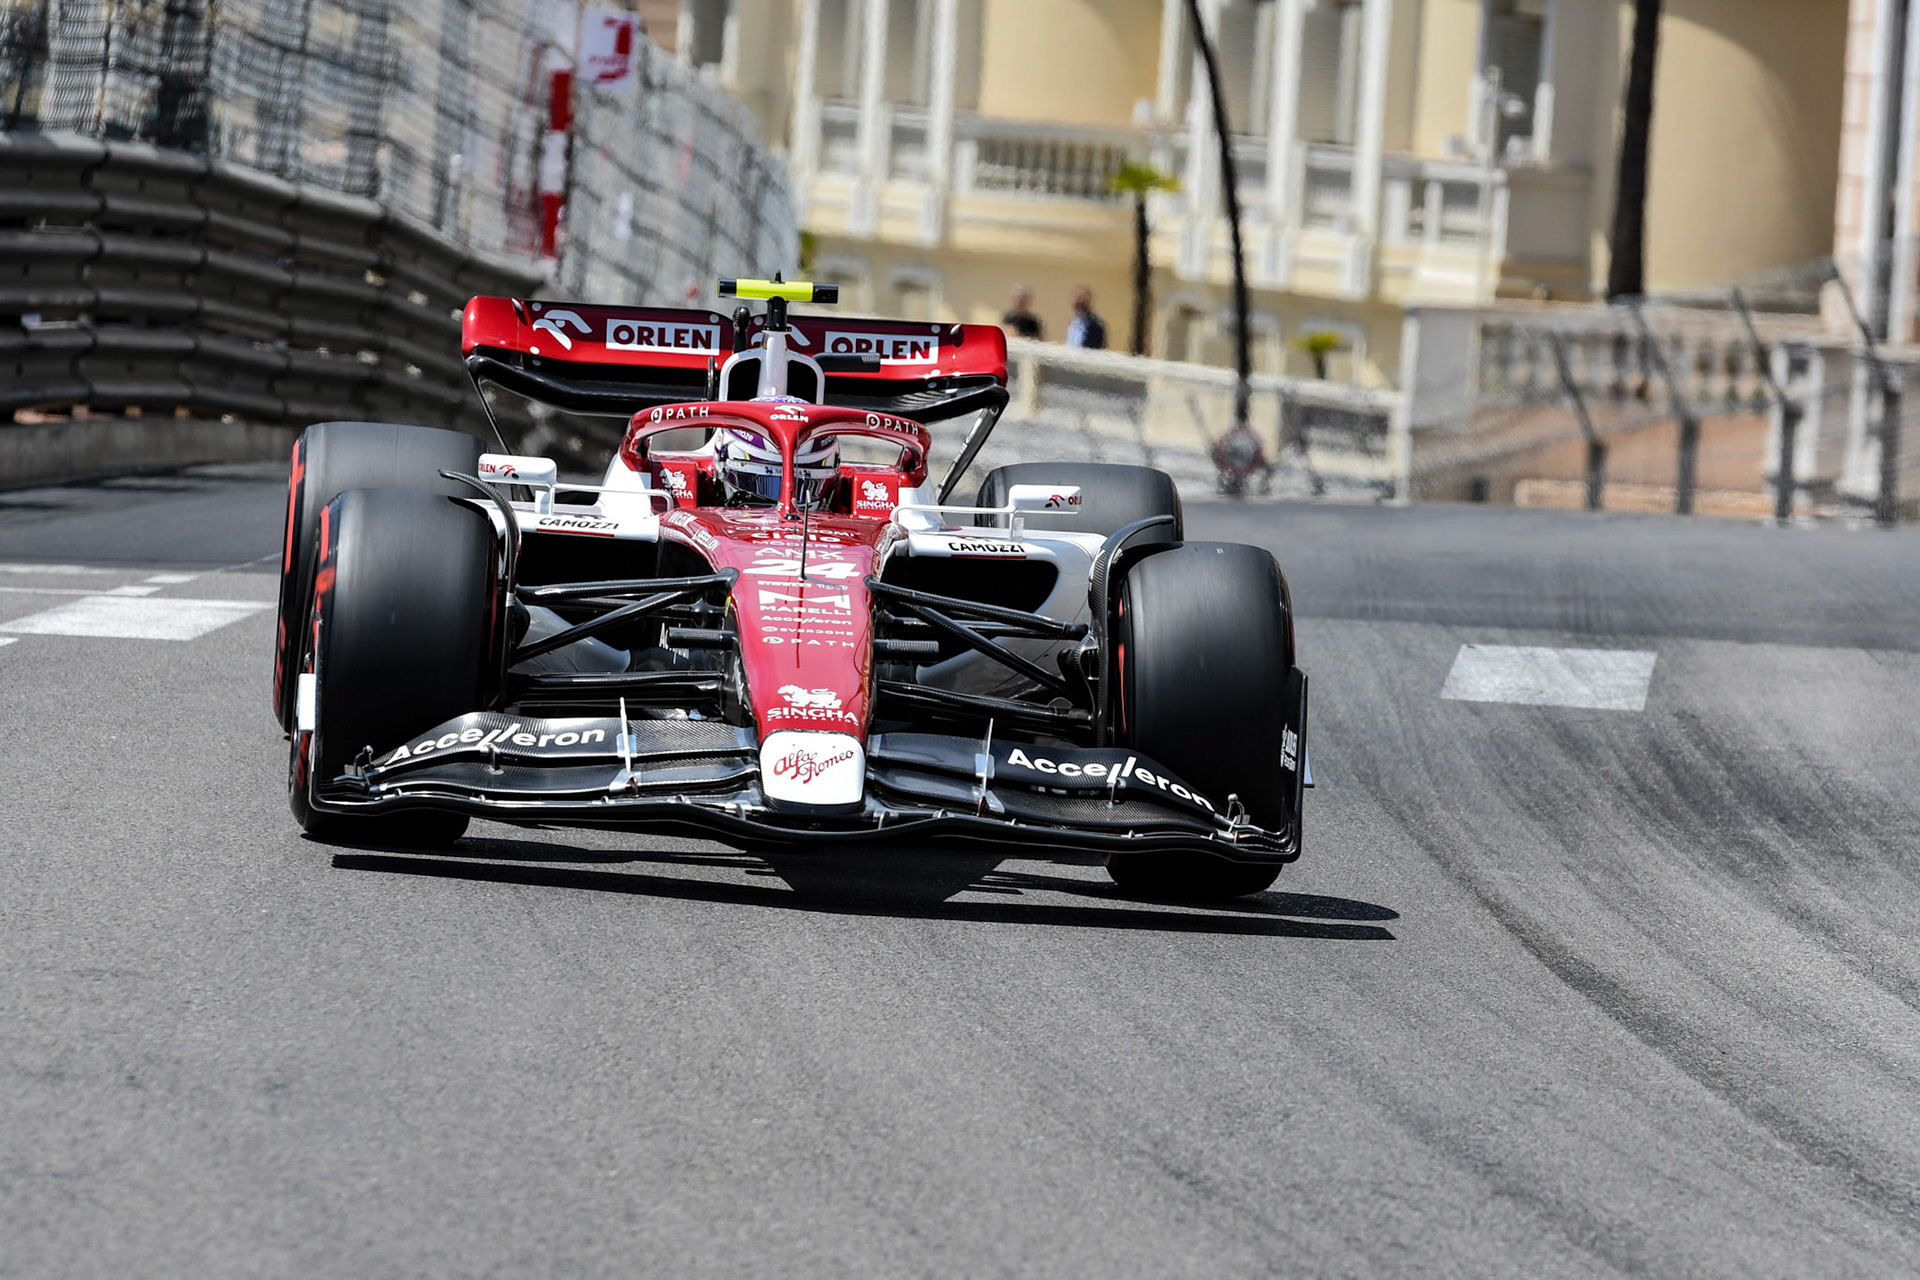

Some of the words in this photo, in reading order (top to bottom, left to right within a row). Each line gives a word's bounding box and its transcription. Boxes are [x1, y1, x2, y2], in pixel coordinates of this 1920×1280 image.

[613, 324, 713, 350] ORLEN
[831, 338, 931, 360] ORLEN
[666, 406, 709, 420] PATH
[769, 413, 809, 423] ORLEN
[884, 417, 919, 436] PATH
[856, 500, 895, 509] SINGHA
[538, 517, 620, 530] CAMOZZI
[948, 542, 1025, 553] CAMOZZI
[742, 558, 861, 580] 24
[760, 605, 852, 616] MARELLI
[791, 638, 855, 648] PATH
[767, 707, 858, 724] SINGHA
[384, 723, 605, 765] Accelleron
[773, 749, 818, 780] Alfa
[799, 750, 854, 785] Romeo
[1007, 748, 1215, 812] Accelleron
